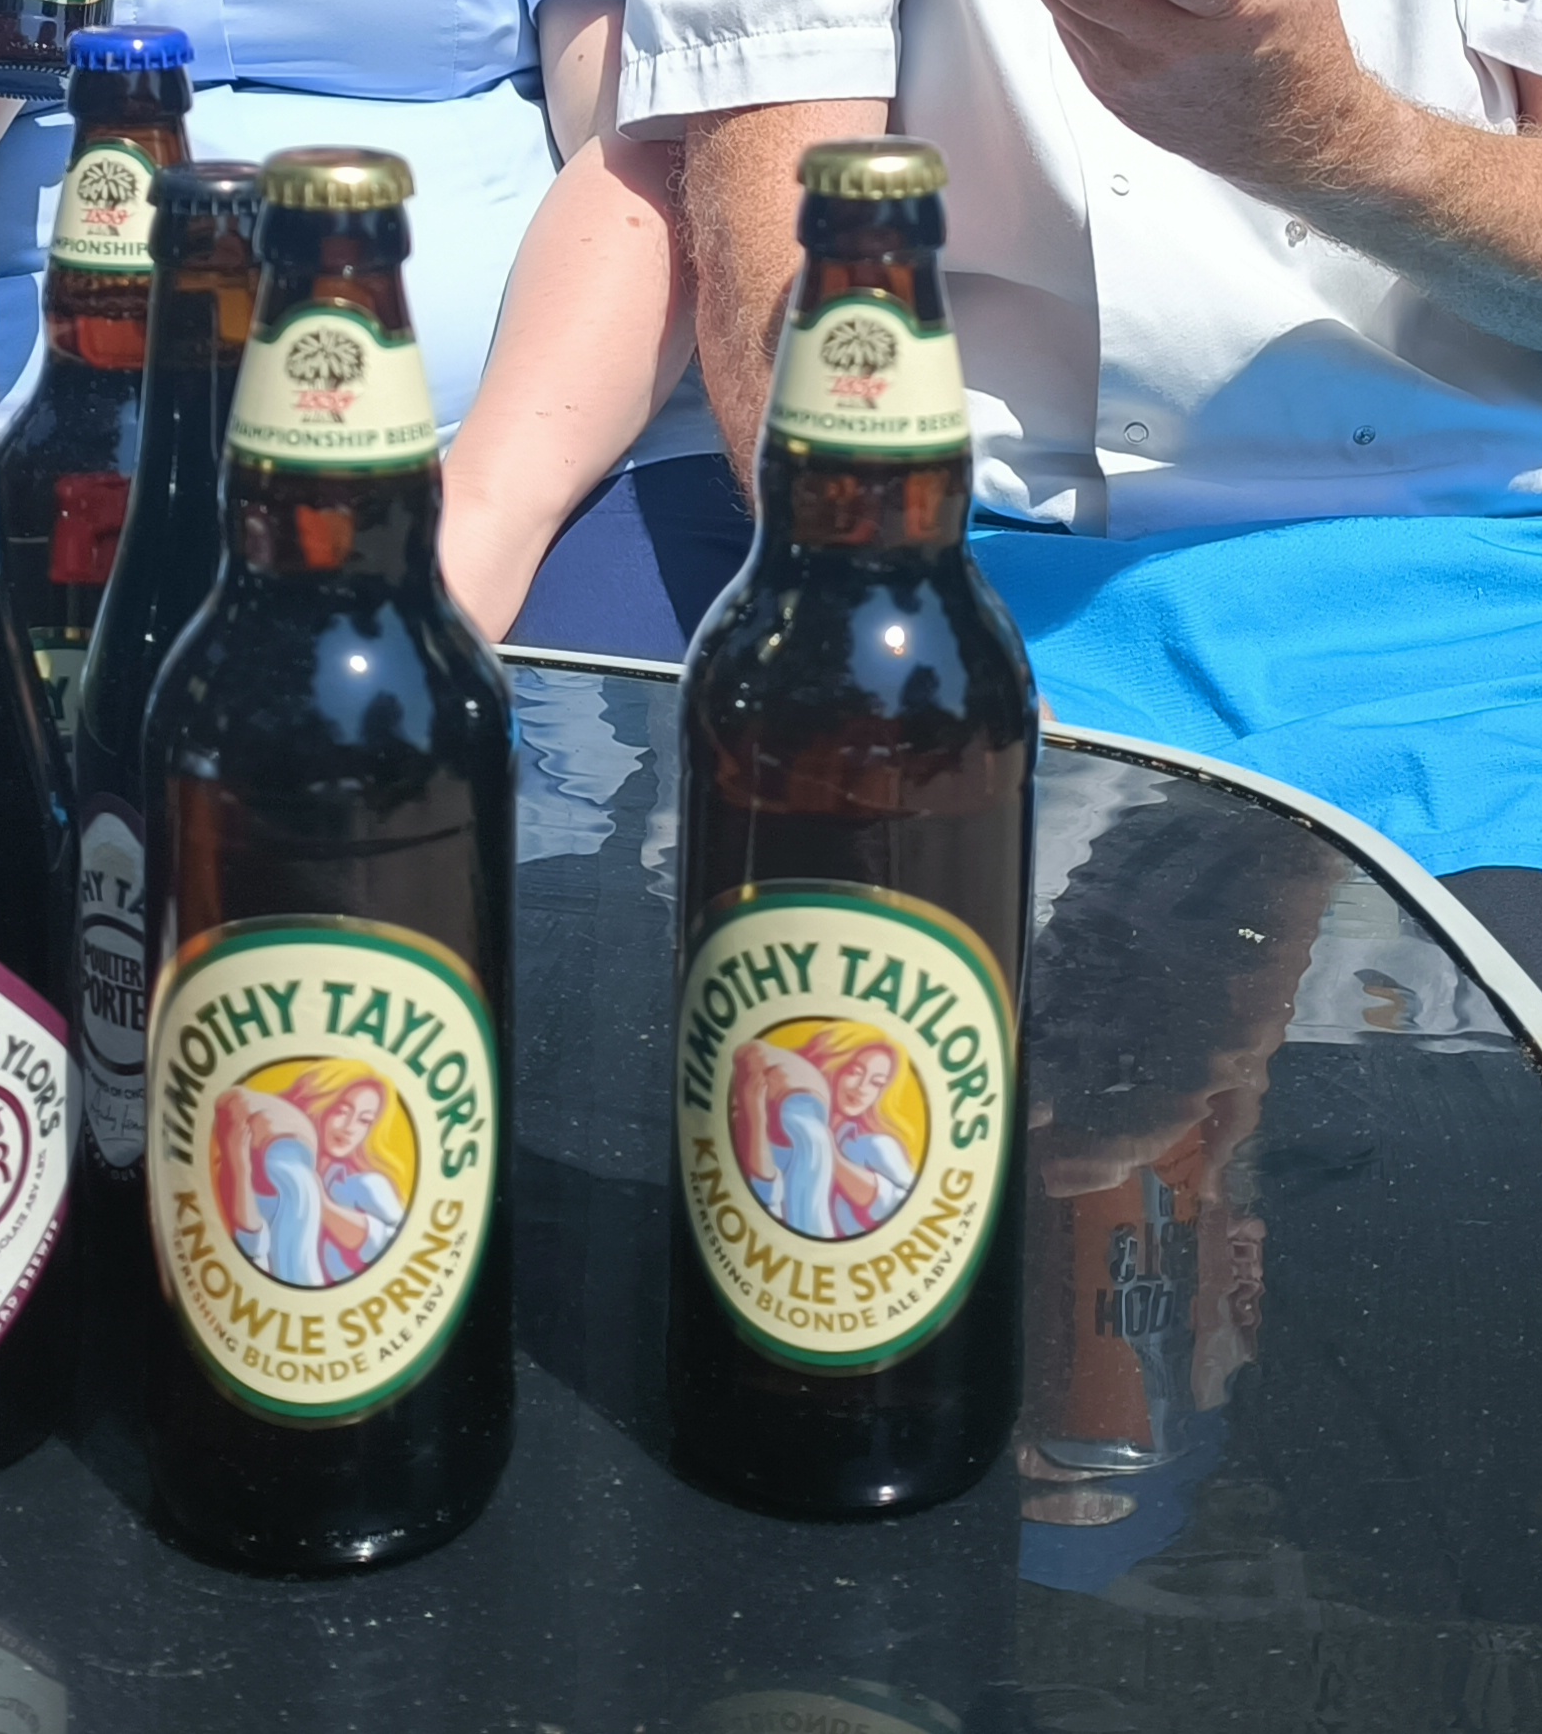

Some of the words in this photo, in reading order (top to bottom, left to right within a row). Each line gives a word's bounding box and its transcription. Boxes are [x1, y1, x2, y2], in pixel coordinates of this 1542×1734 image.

[163, 979, 304, 1166] TIMOTHY
[323, 980, 486, 1181] TAYLOR'S
[683, 942, 820, 1113] TIMOTHY
[839, 944, 1002, 1152] TAYLOR'S
[172, 1190, 327, 1357] KNOWLE
[338, 1198, 465, 1351] SPRING
[688, 1171, 753, 1297] REFRESHING
[755, 1288, 878, 1334] BLONDE
[886, 1288, 922, 1320] ALE
[923, 1253, 954, 1291] ABV
[691, 1136, 838, 1305] KNOWLE
[848, 1167, 975, 1304] SPRING
[241, 1344, 370, 1386] BLONDE
[377, 1327, 413, 1362] ALE
[414, 1285, 445, 1329] ABV
